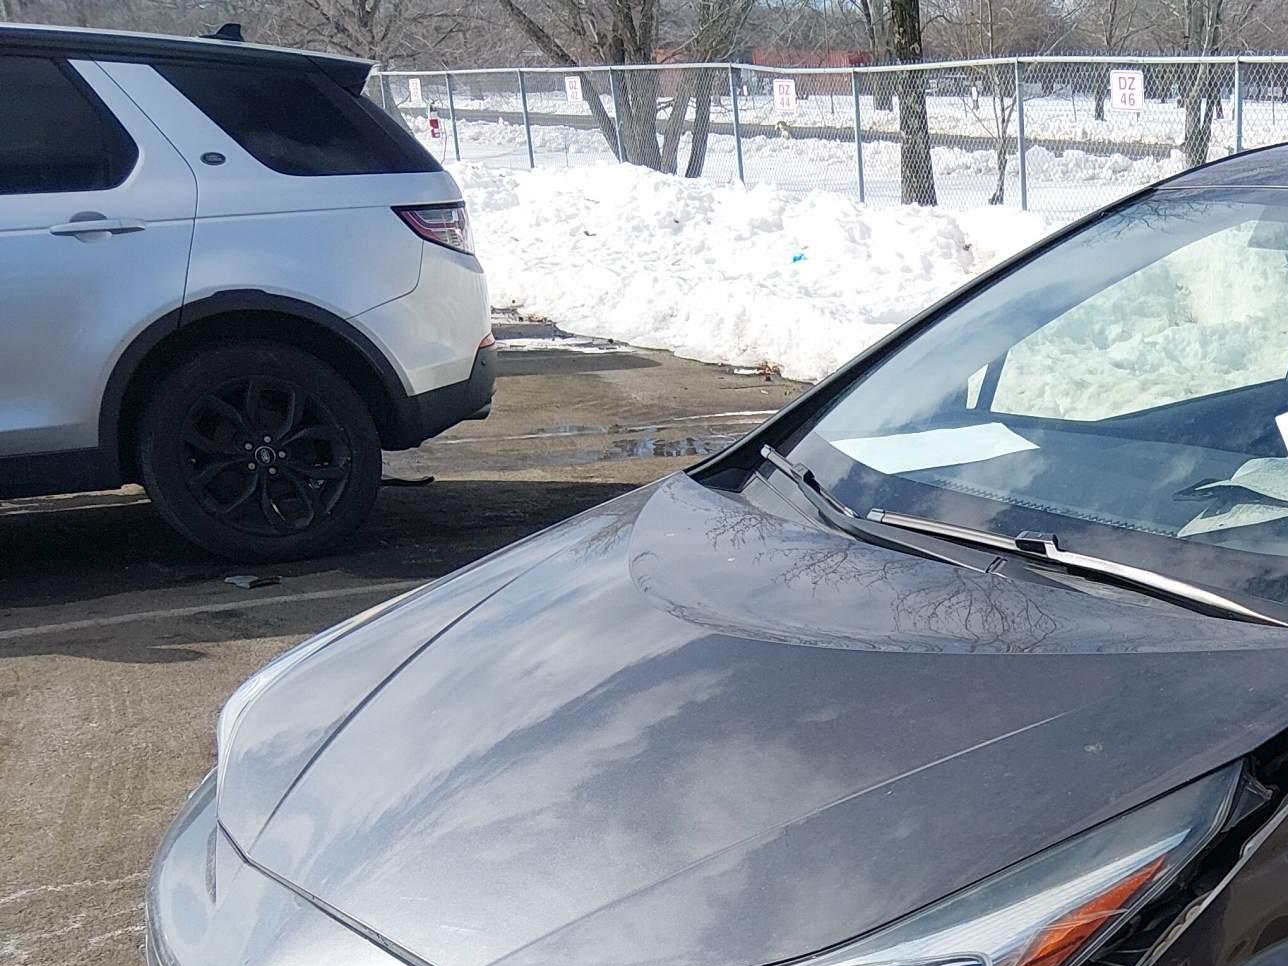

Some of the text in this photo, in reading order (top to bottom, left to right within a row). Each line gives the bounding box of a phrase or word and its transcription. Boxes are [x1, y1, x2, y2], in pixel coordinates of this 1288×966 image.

[778, 84, 790, 95] DZ
[1118, 76, 1136, 90] DZ
[779, 96, 791, 108] 44
[1120, 92, 1136, 106] 46
